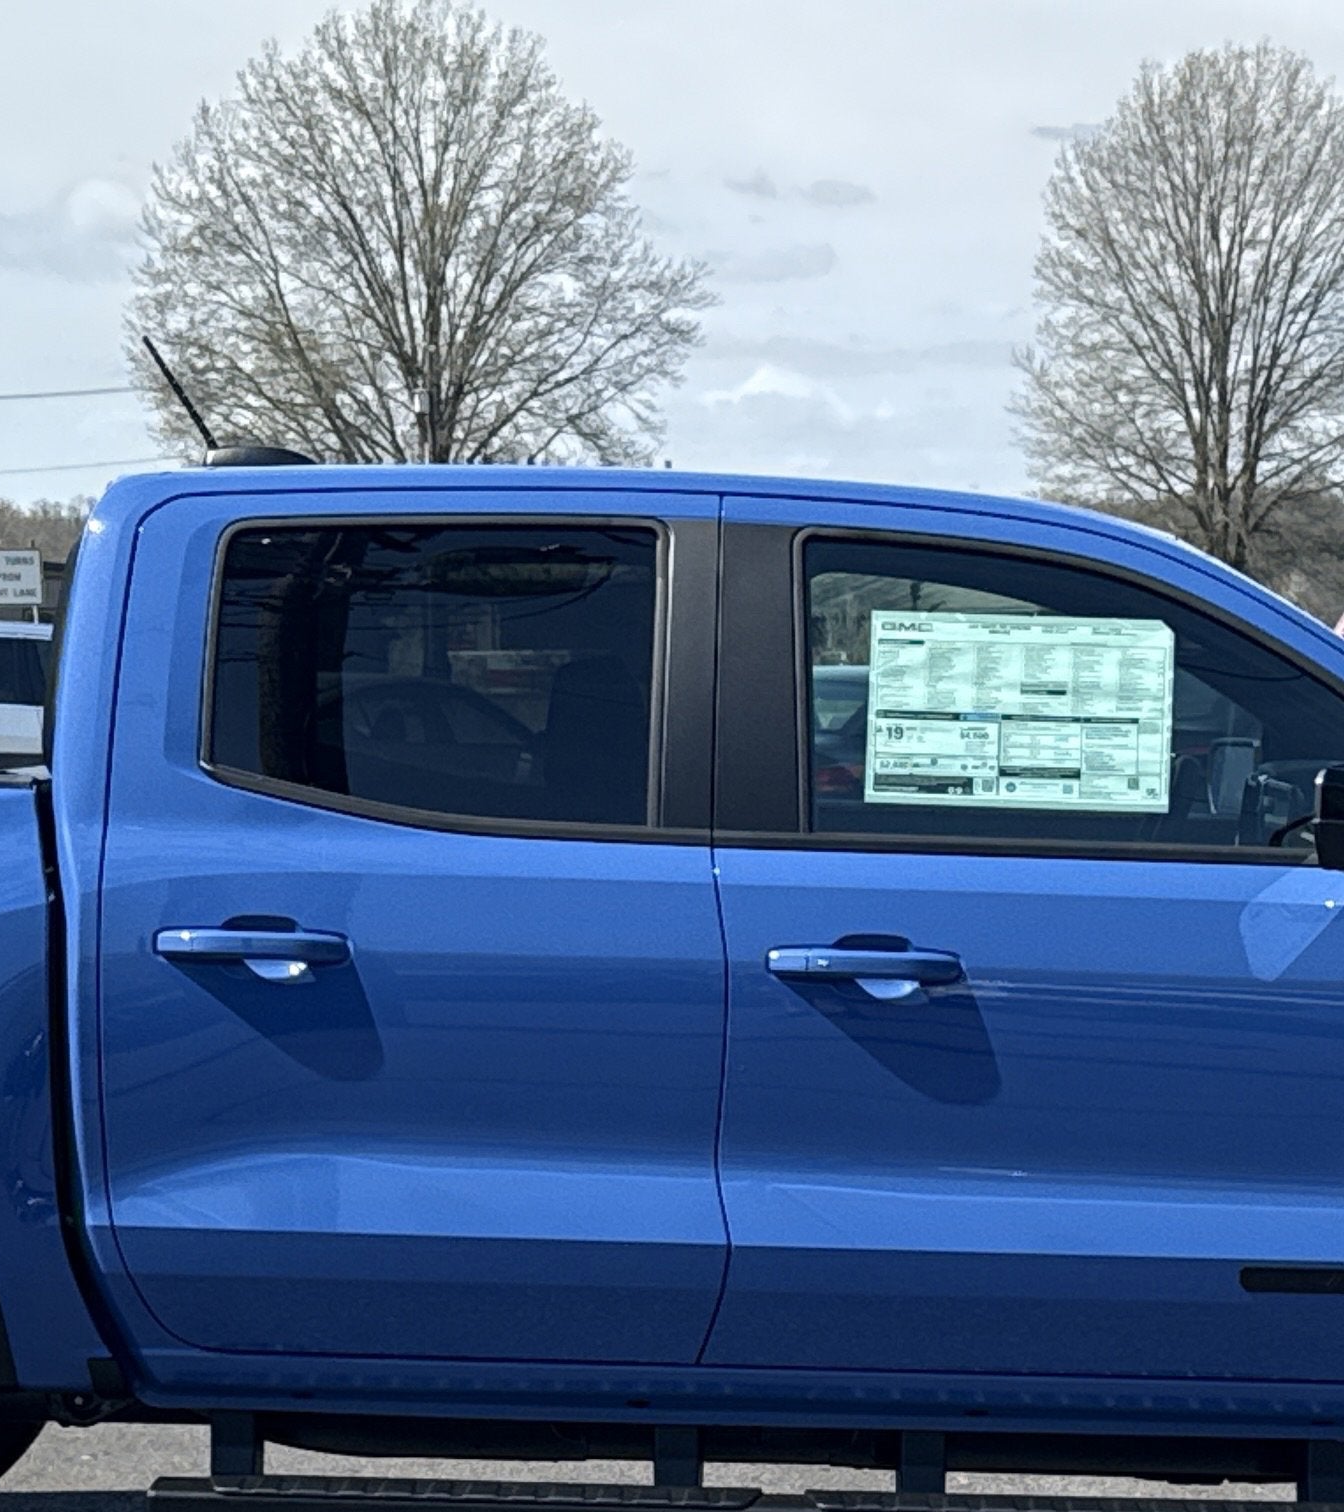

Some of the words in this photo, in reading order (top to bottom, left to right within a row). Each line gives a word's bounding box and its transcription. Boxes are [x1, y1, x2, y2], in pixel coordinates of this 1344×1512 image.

[5, 556, 35, 566] TURNS
[881, 622, 933, 632] GMC
[886, 726, 904, 740] 19
